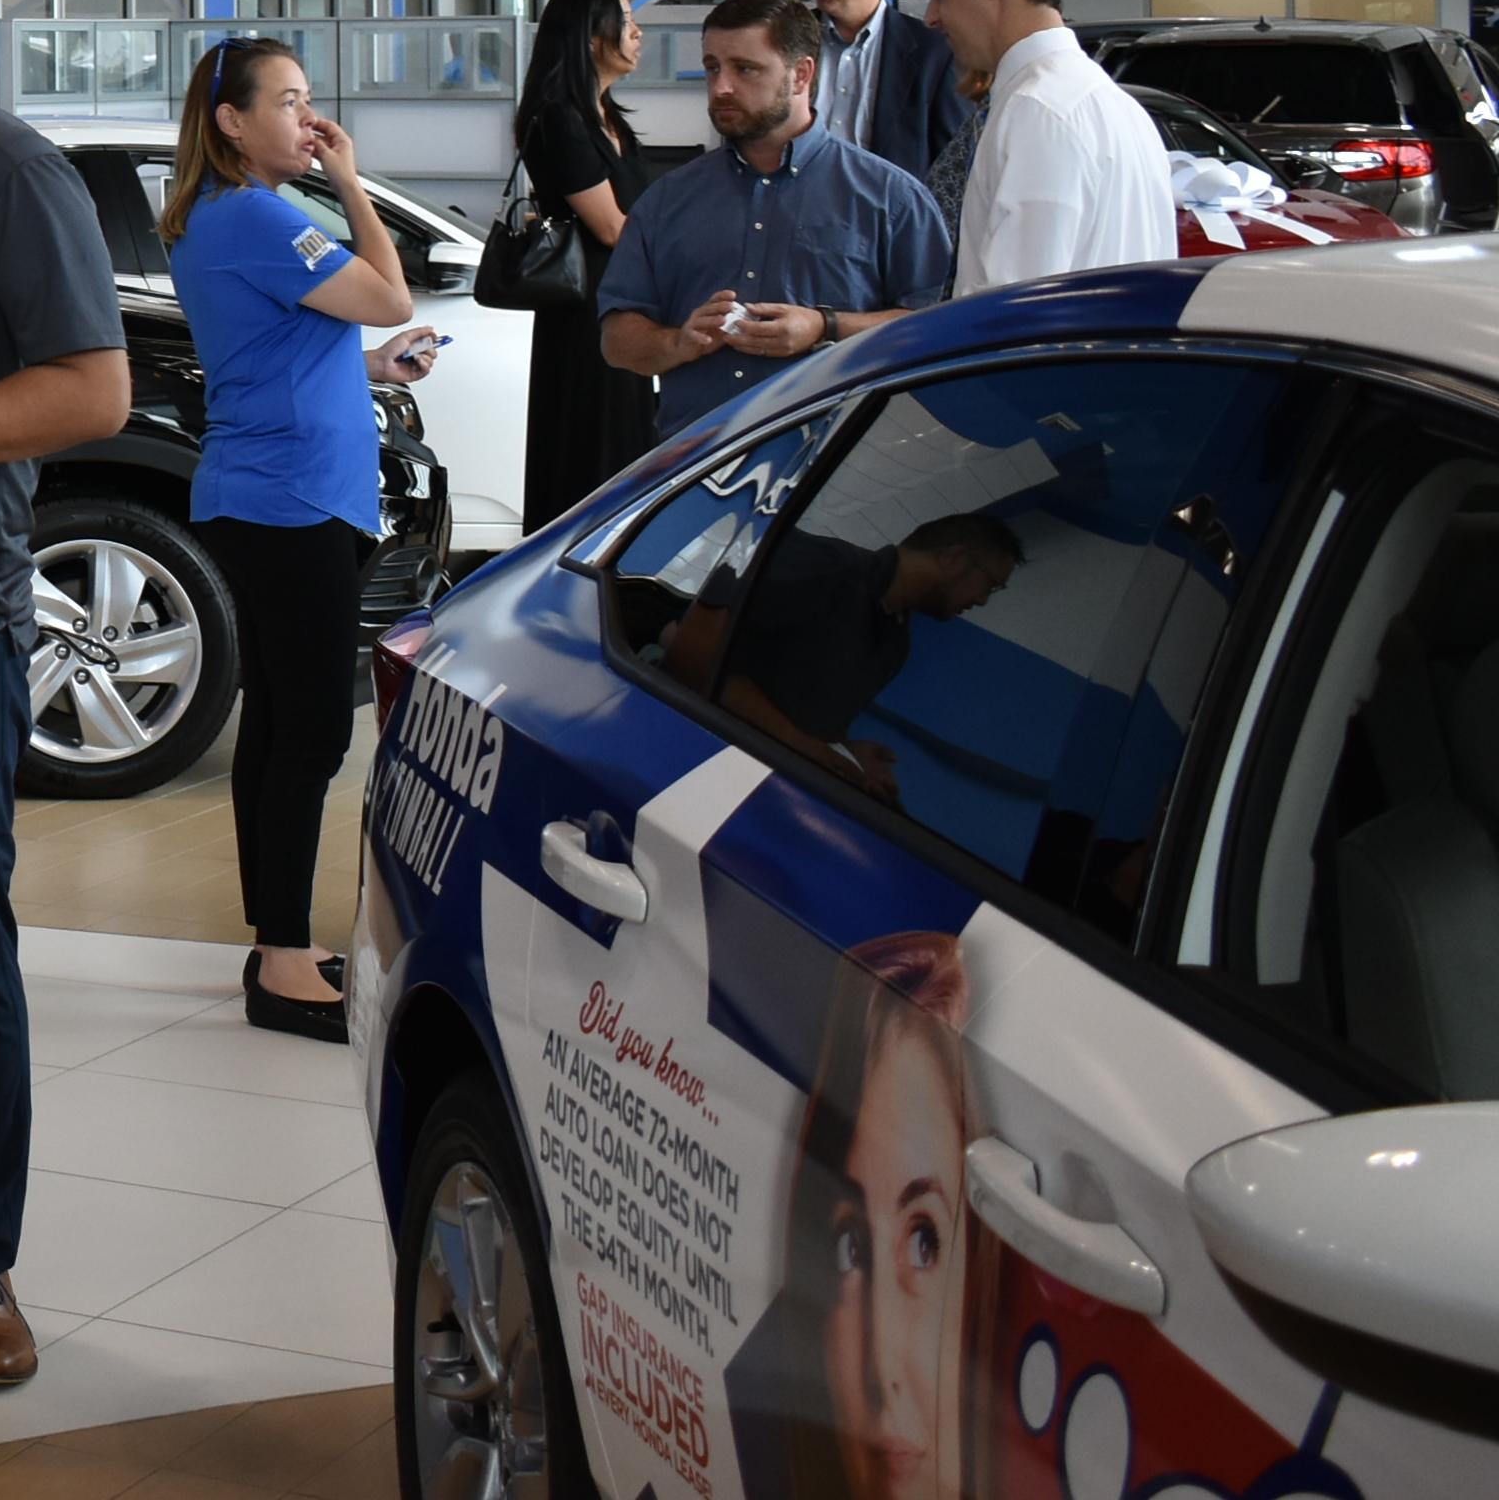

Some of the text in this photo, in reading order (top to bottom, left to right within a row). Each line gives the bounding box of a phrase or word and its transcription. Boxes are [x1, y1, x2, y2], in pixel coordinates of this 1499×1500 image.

[398, 642, 508, 815] Honda
[579, 980, 624, 1043] Did
[616, 1027, 654, 1070] you
[542, 1029, 739, 1214] AN AVERAGE 72-MONTH
[545, 1082, 732, 1263] AUTO LOAN DOES NOT
[540, 1126, 738, 1327] DEVELOP EQUITY UNTIL
[561, 1192, 714, 1358] THE 54TH MONTH.
[577, 1272, 705, 1414] GAP INSURANCE
[580, 1308, 709, 1469] INCLUDED
[597, 1381, 630, 1426] EVERY
[632, 1411, 672, 1468] HONDA
